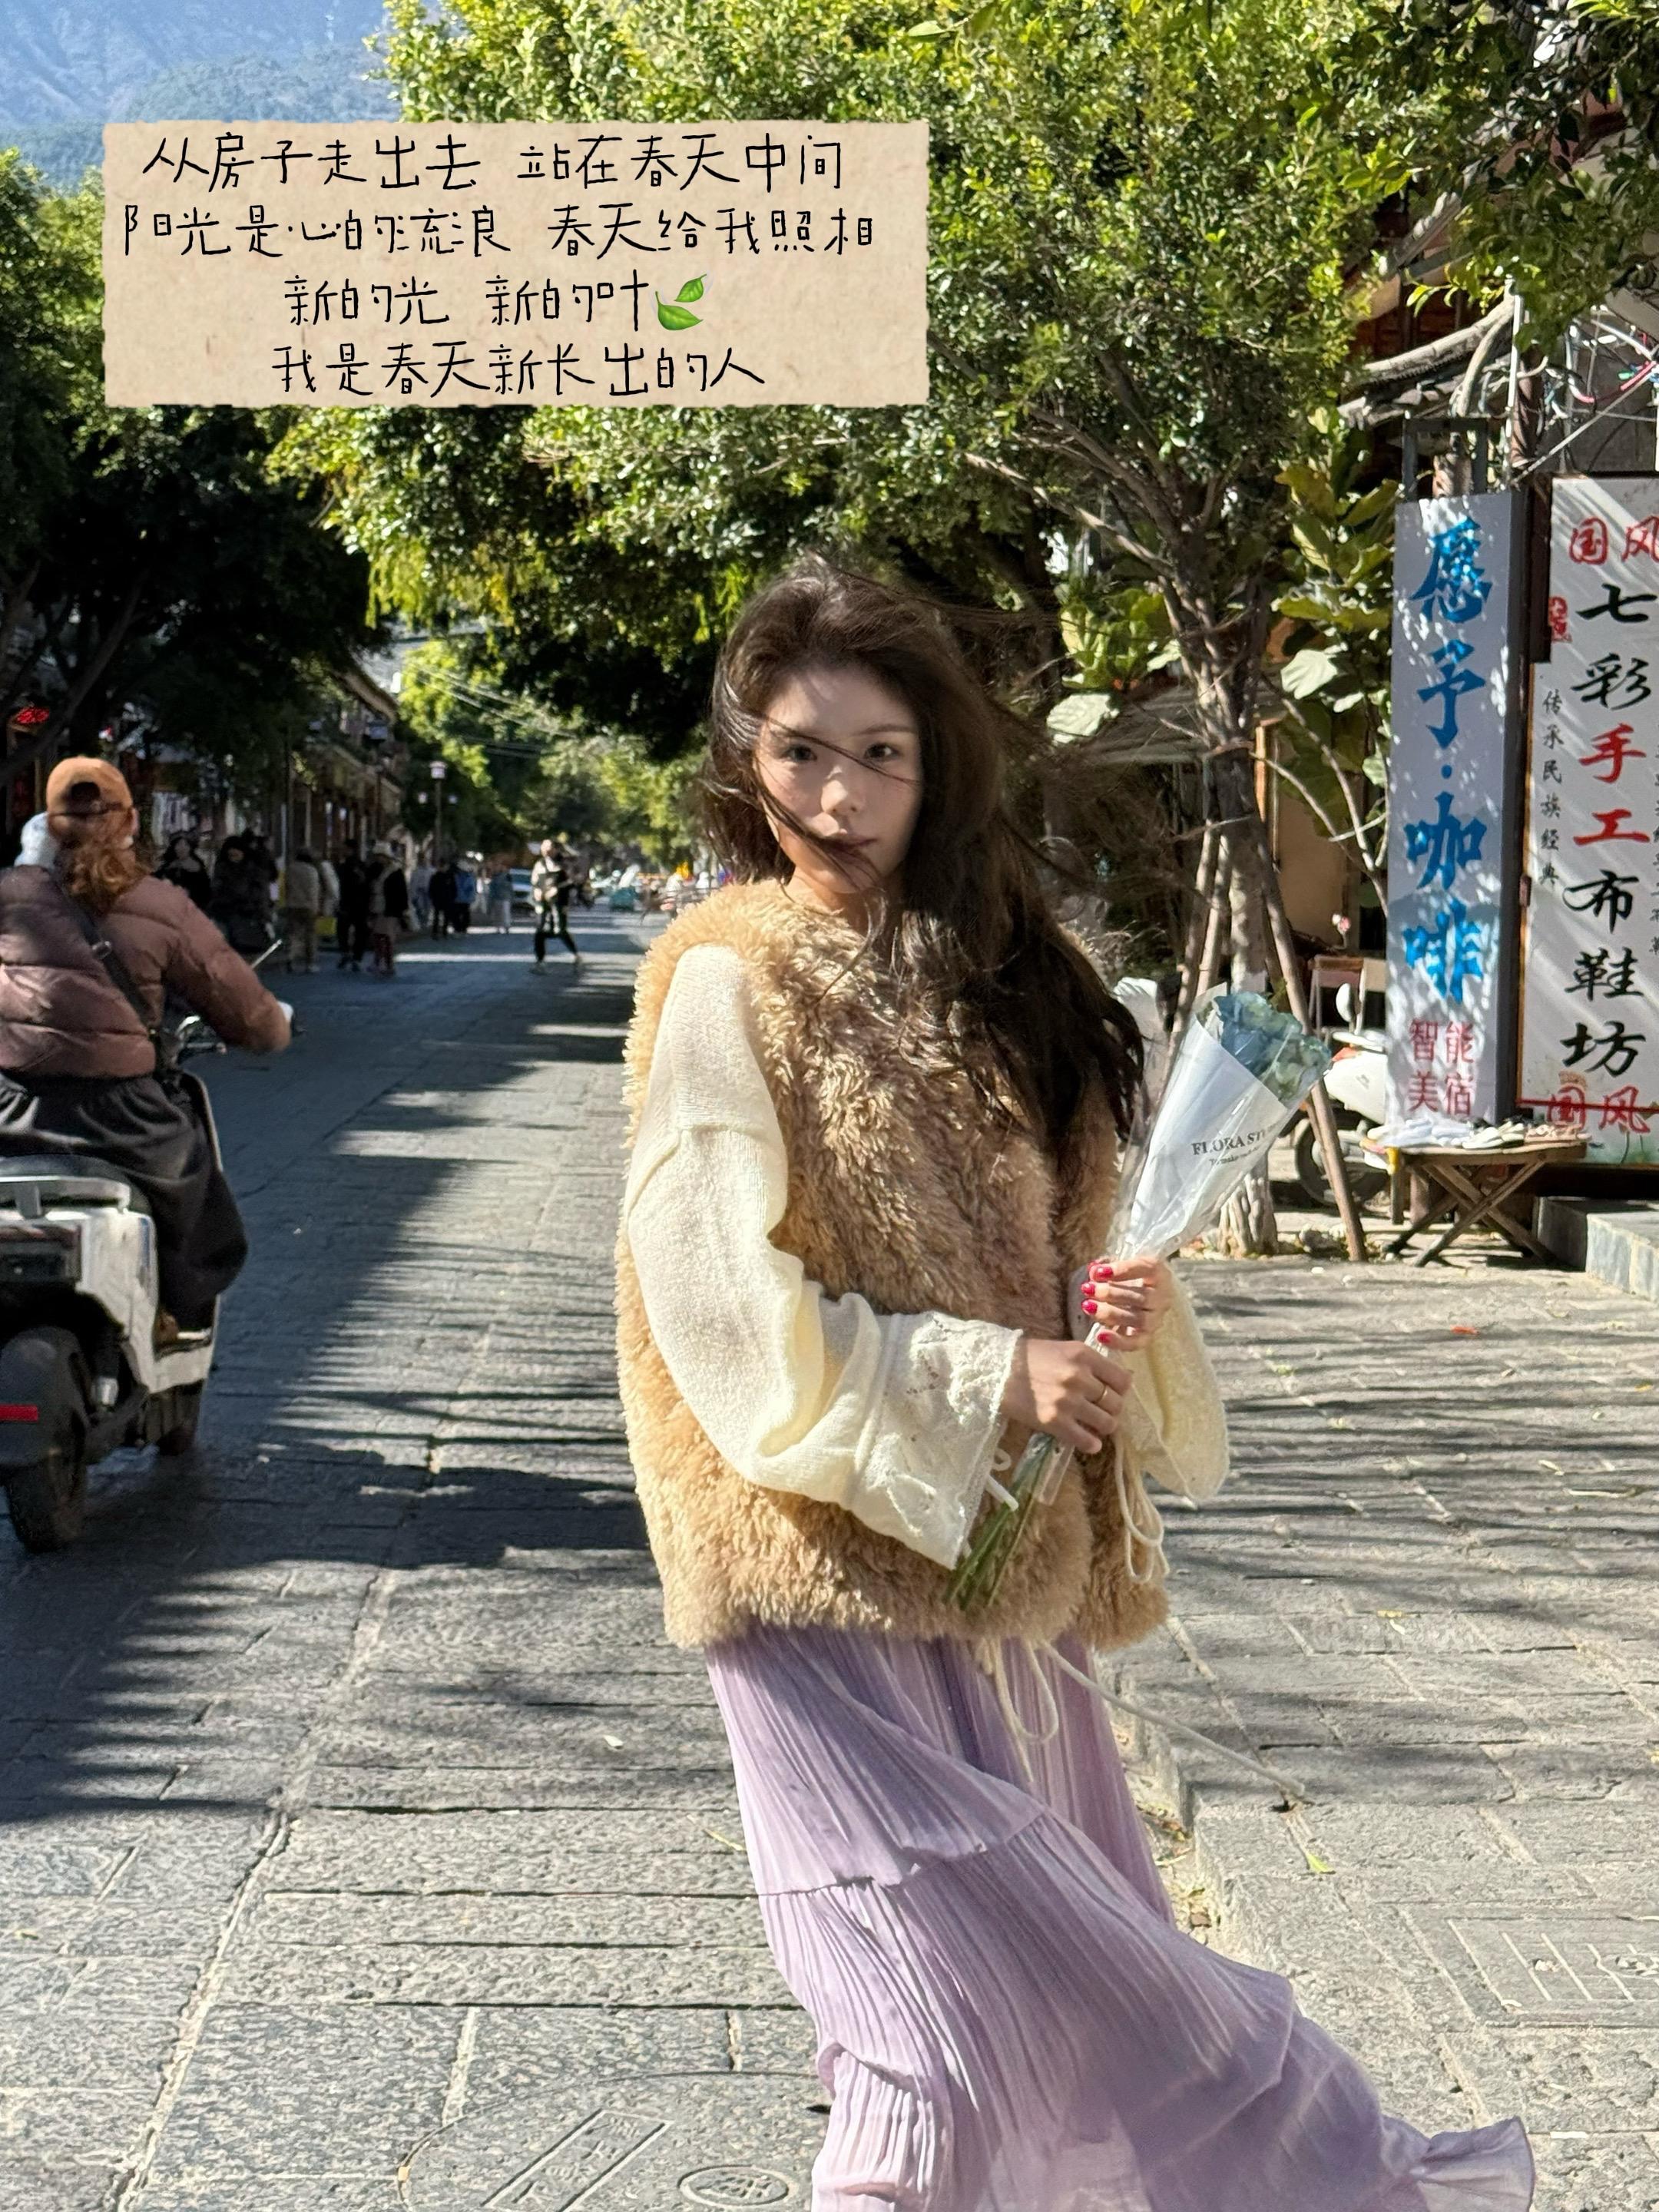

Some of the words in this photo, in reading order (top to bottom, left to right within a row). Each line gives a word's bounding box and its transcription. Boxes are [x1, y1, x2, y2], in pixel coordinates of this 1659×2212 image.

[1540, 689, 1564, 889] 传承民族经典
[1561, 583, 1657, 1077] 七彩手工布鞋坊
[1408, 1071, 1474, 1116] 美宿
[1409, 1018, 1474, 1063] 智能
